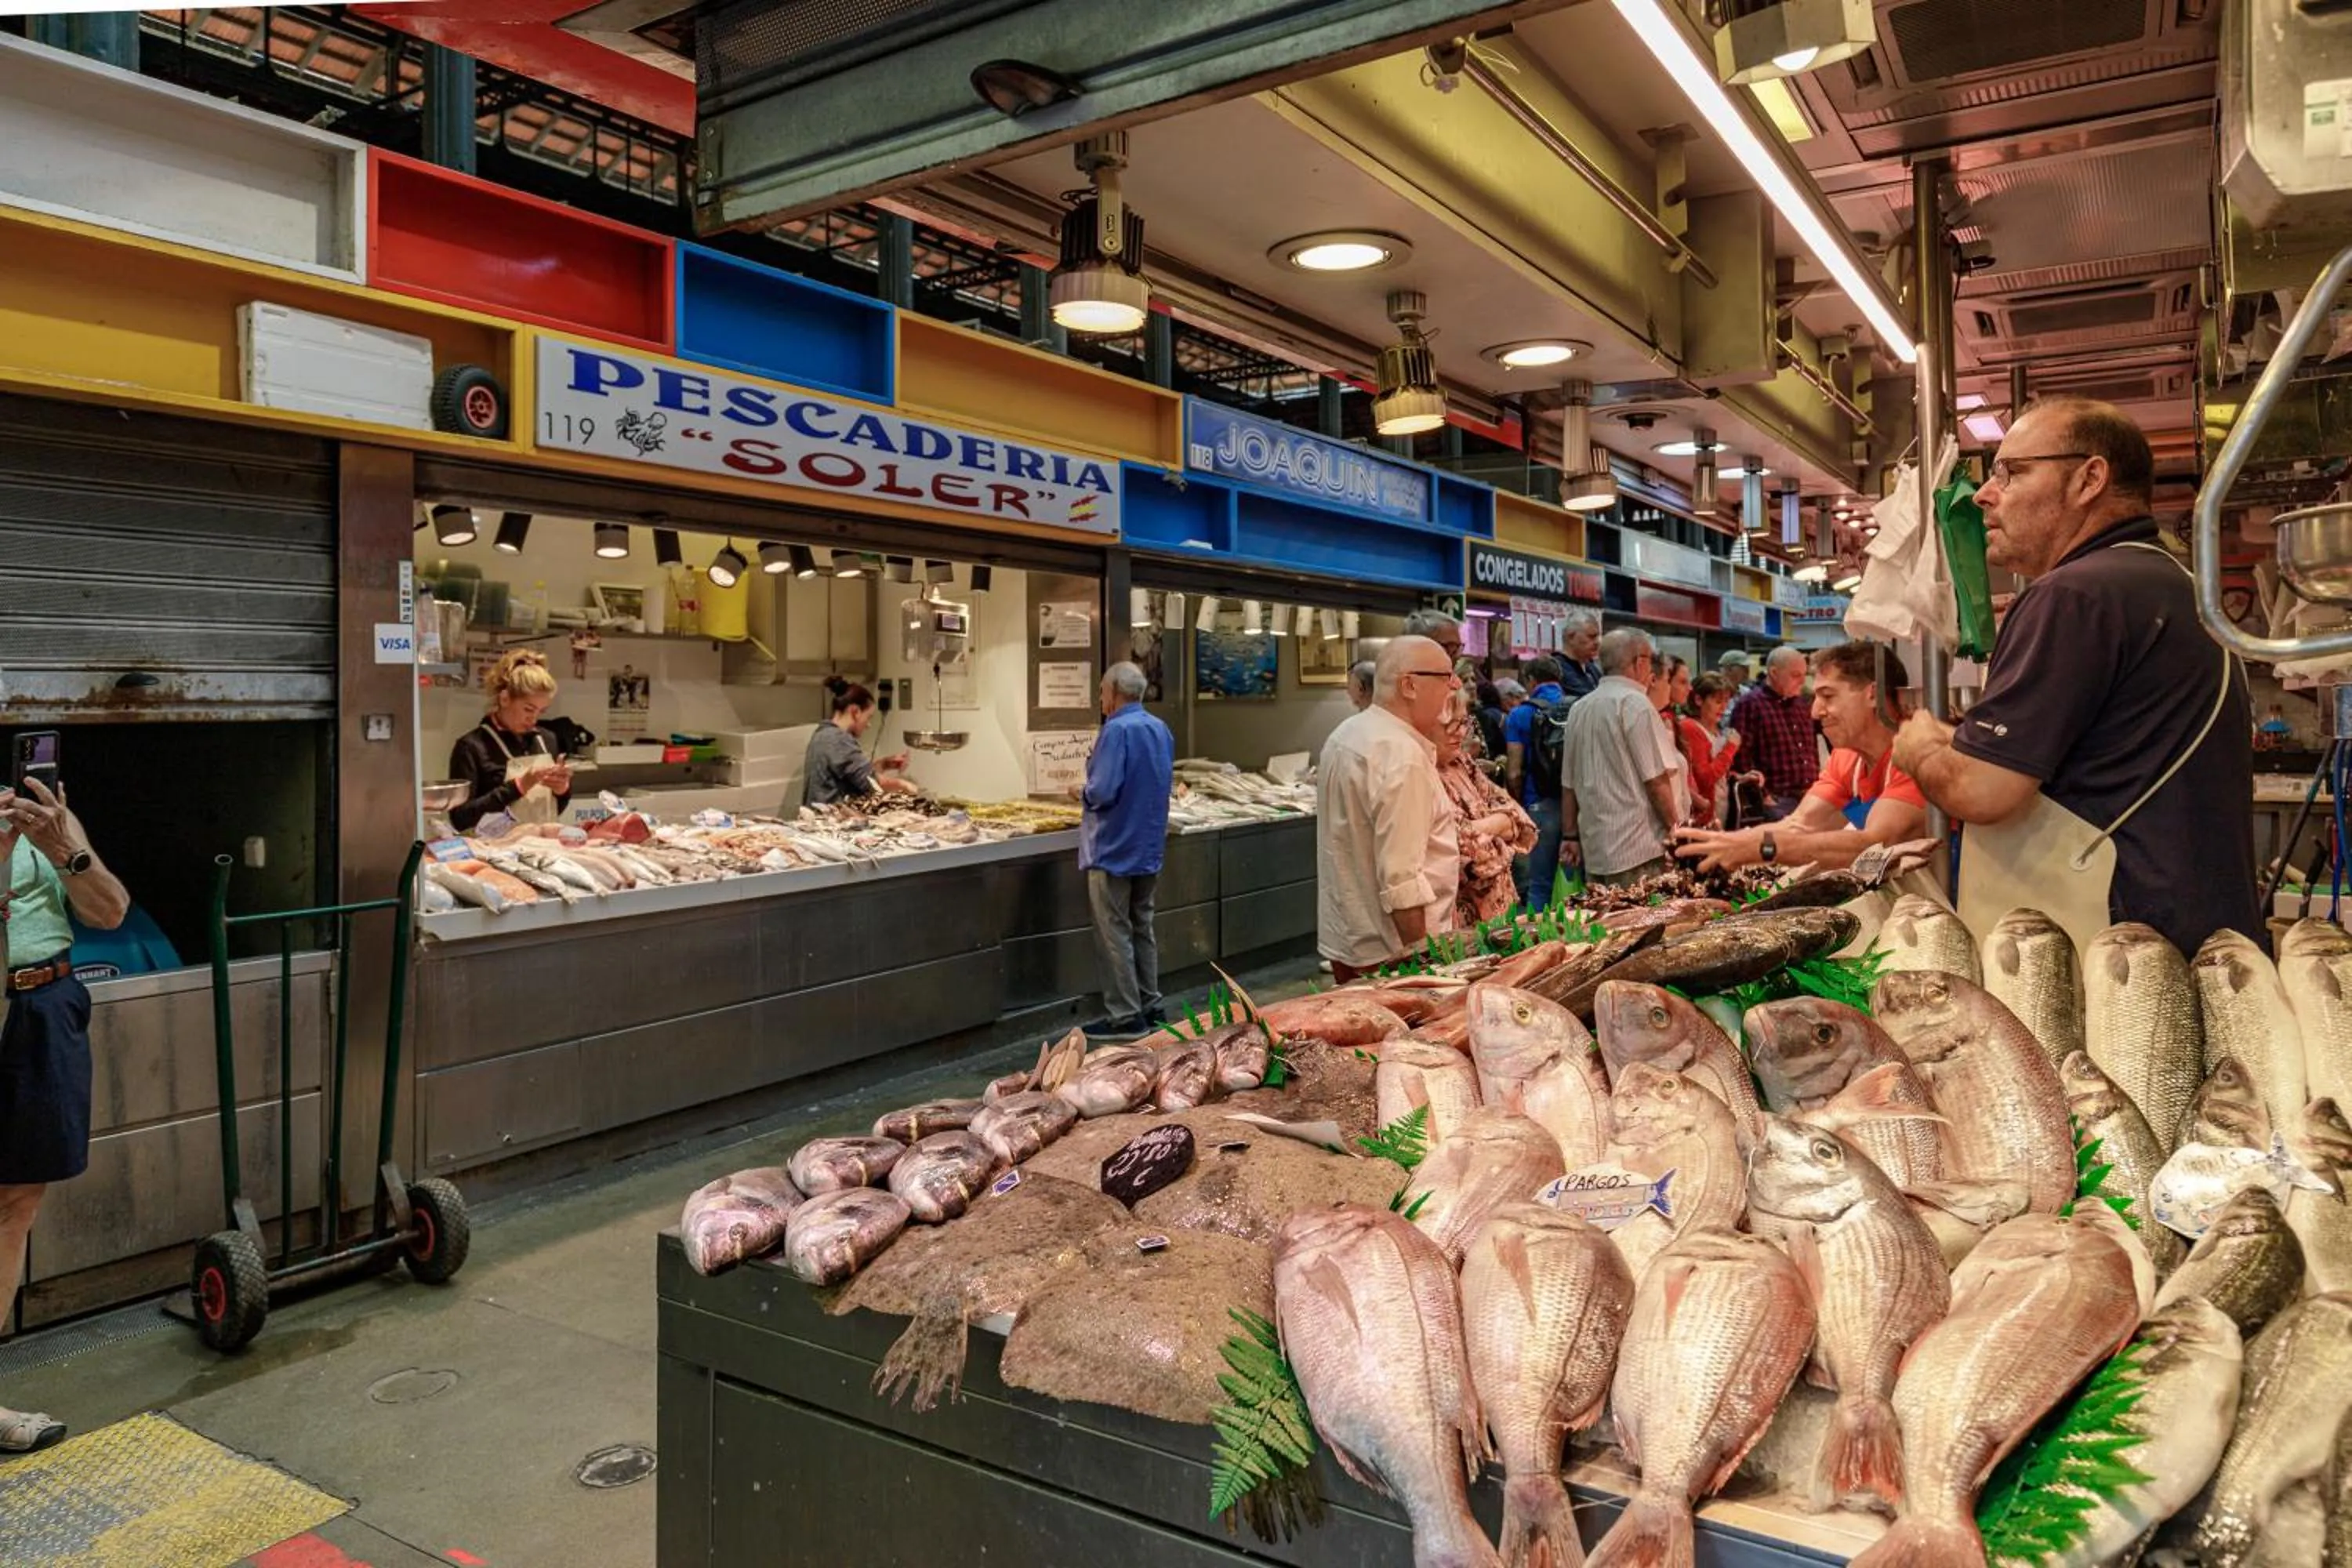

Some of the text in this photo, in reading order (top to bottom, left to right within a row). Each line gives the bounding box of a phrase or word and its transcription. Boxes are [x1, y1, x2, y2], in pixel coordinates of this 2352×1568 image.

[544, 411, 595, 445] 119
[566, 348, 1113, 494] PESCADERIA
[1191, 446, 1212, 468] 118
[1218, 422, 1379, 504] JOAQUIN
[1475, 552, 1565, 594] CONGELADOS
[379, 637, 411, 650] VISA
[1564, 1174, 1632, 1192] PARGOS
